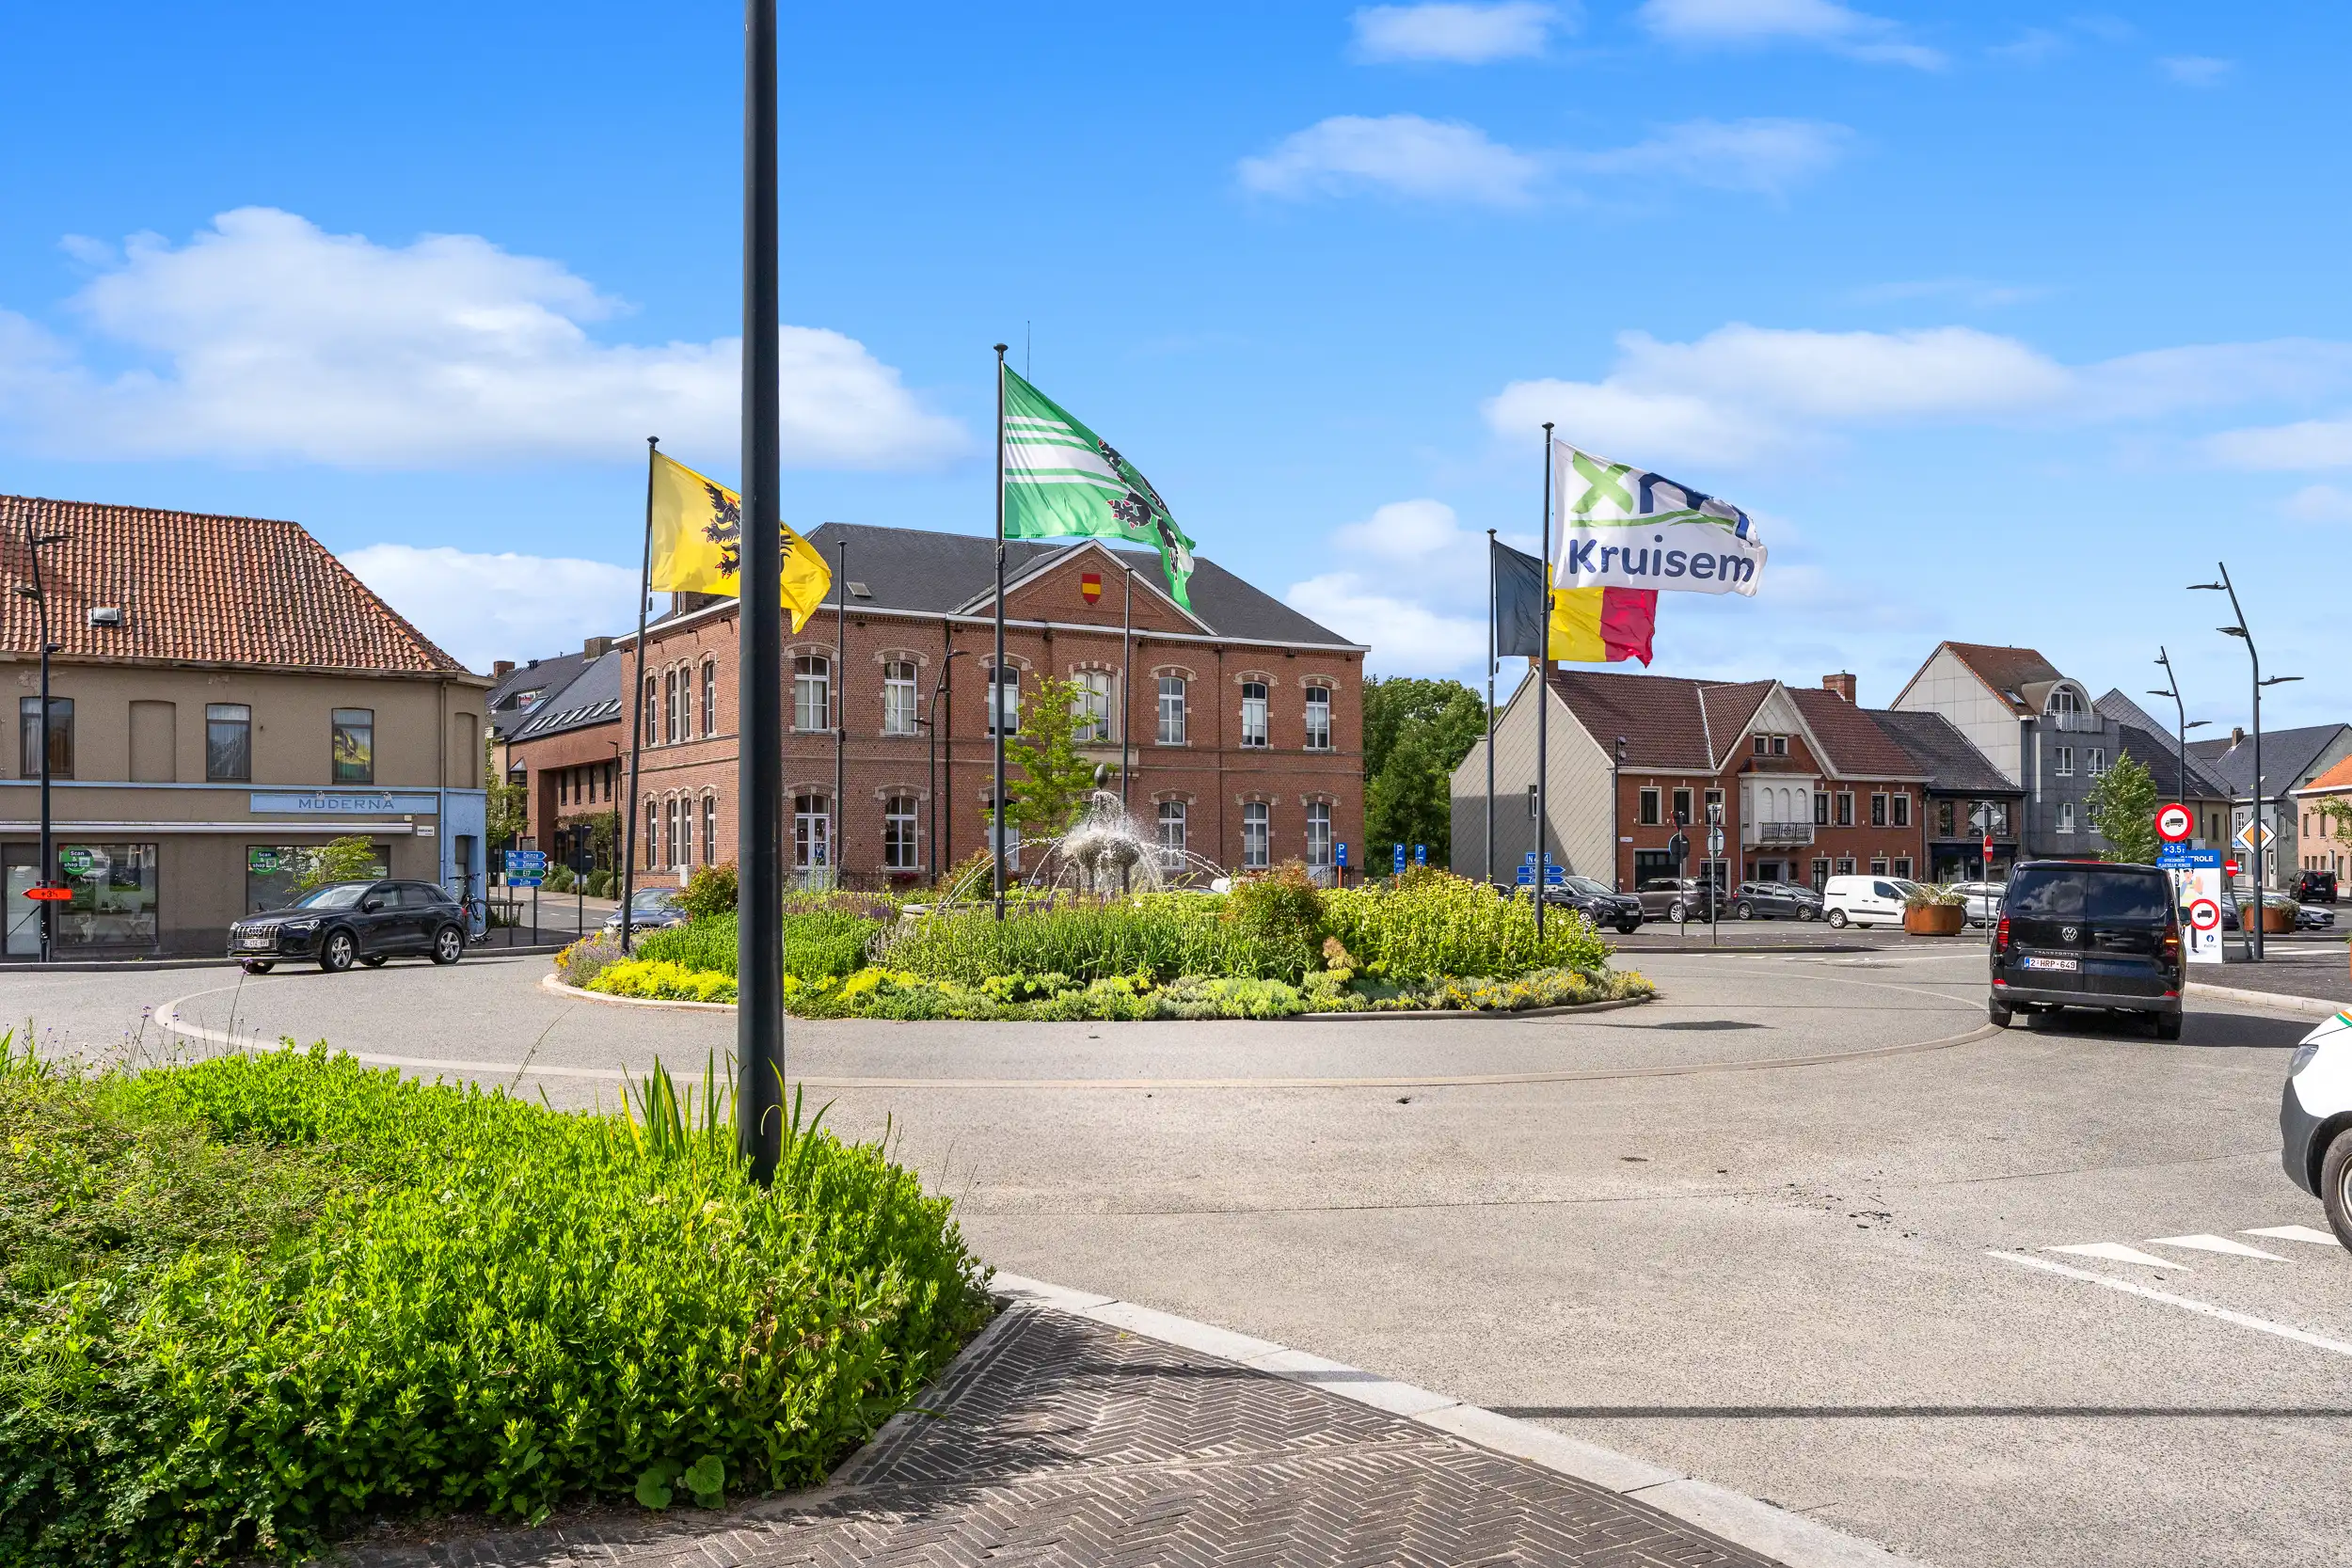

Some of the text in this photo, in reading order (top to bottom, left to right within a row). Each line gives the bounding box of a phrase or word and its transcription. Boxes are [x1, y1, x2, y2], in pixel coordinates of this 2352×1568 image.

[1568, 534, 1755, 583] Kruisem
[298, 798, 394, 809] MODERNA
[1338, 844, 1345, 853] P
[1396, 845, 1403, 855] P
[1418, 846, 1423, 854] P
